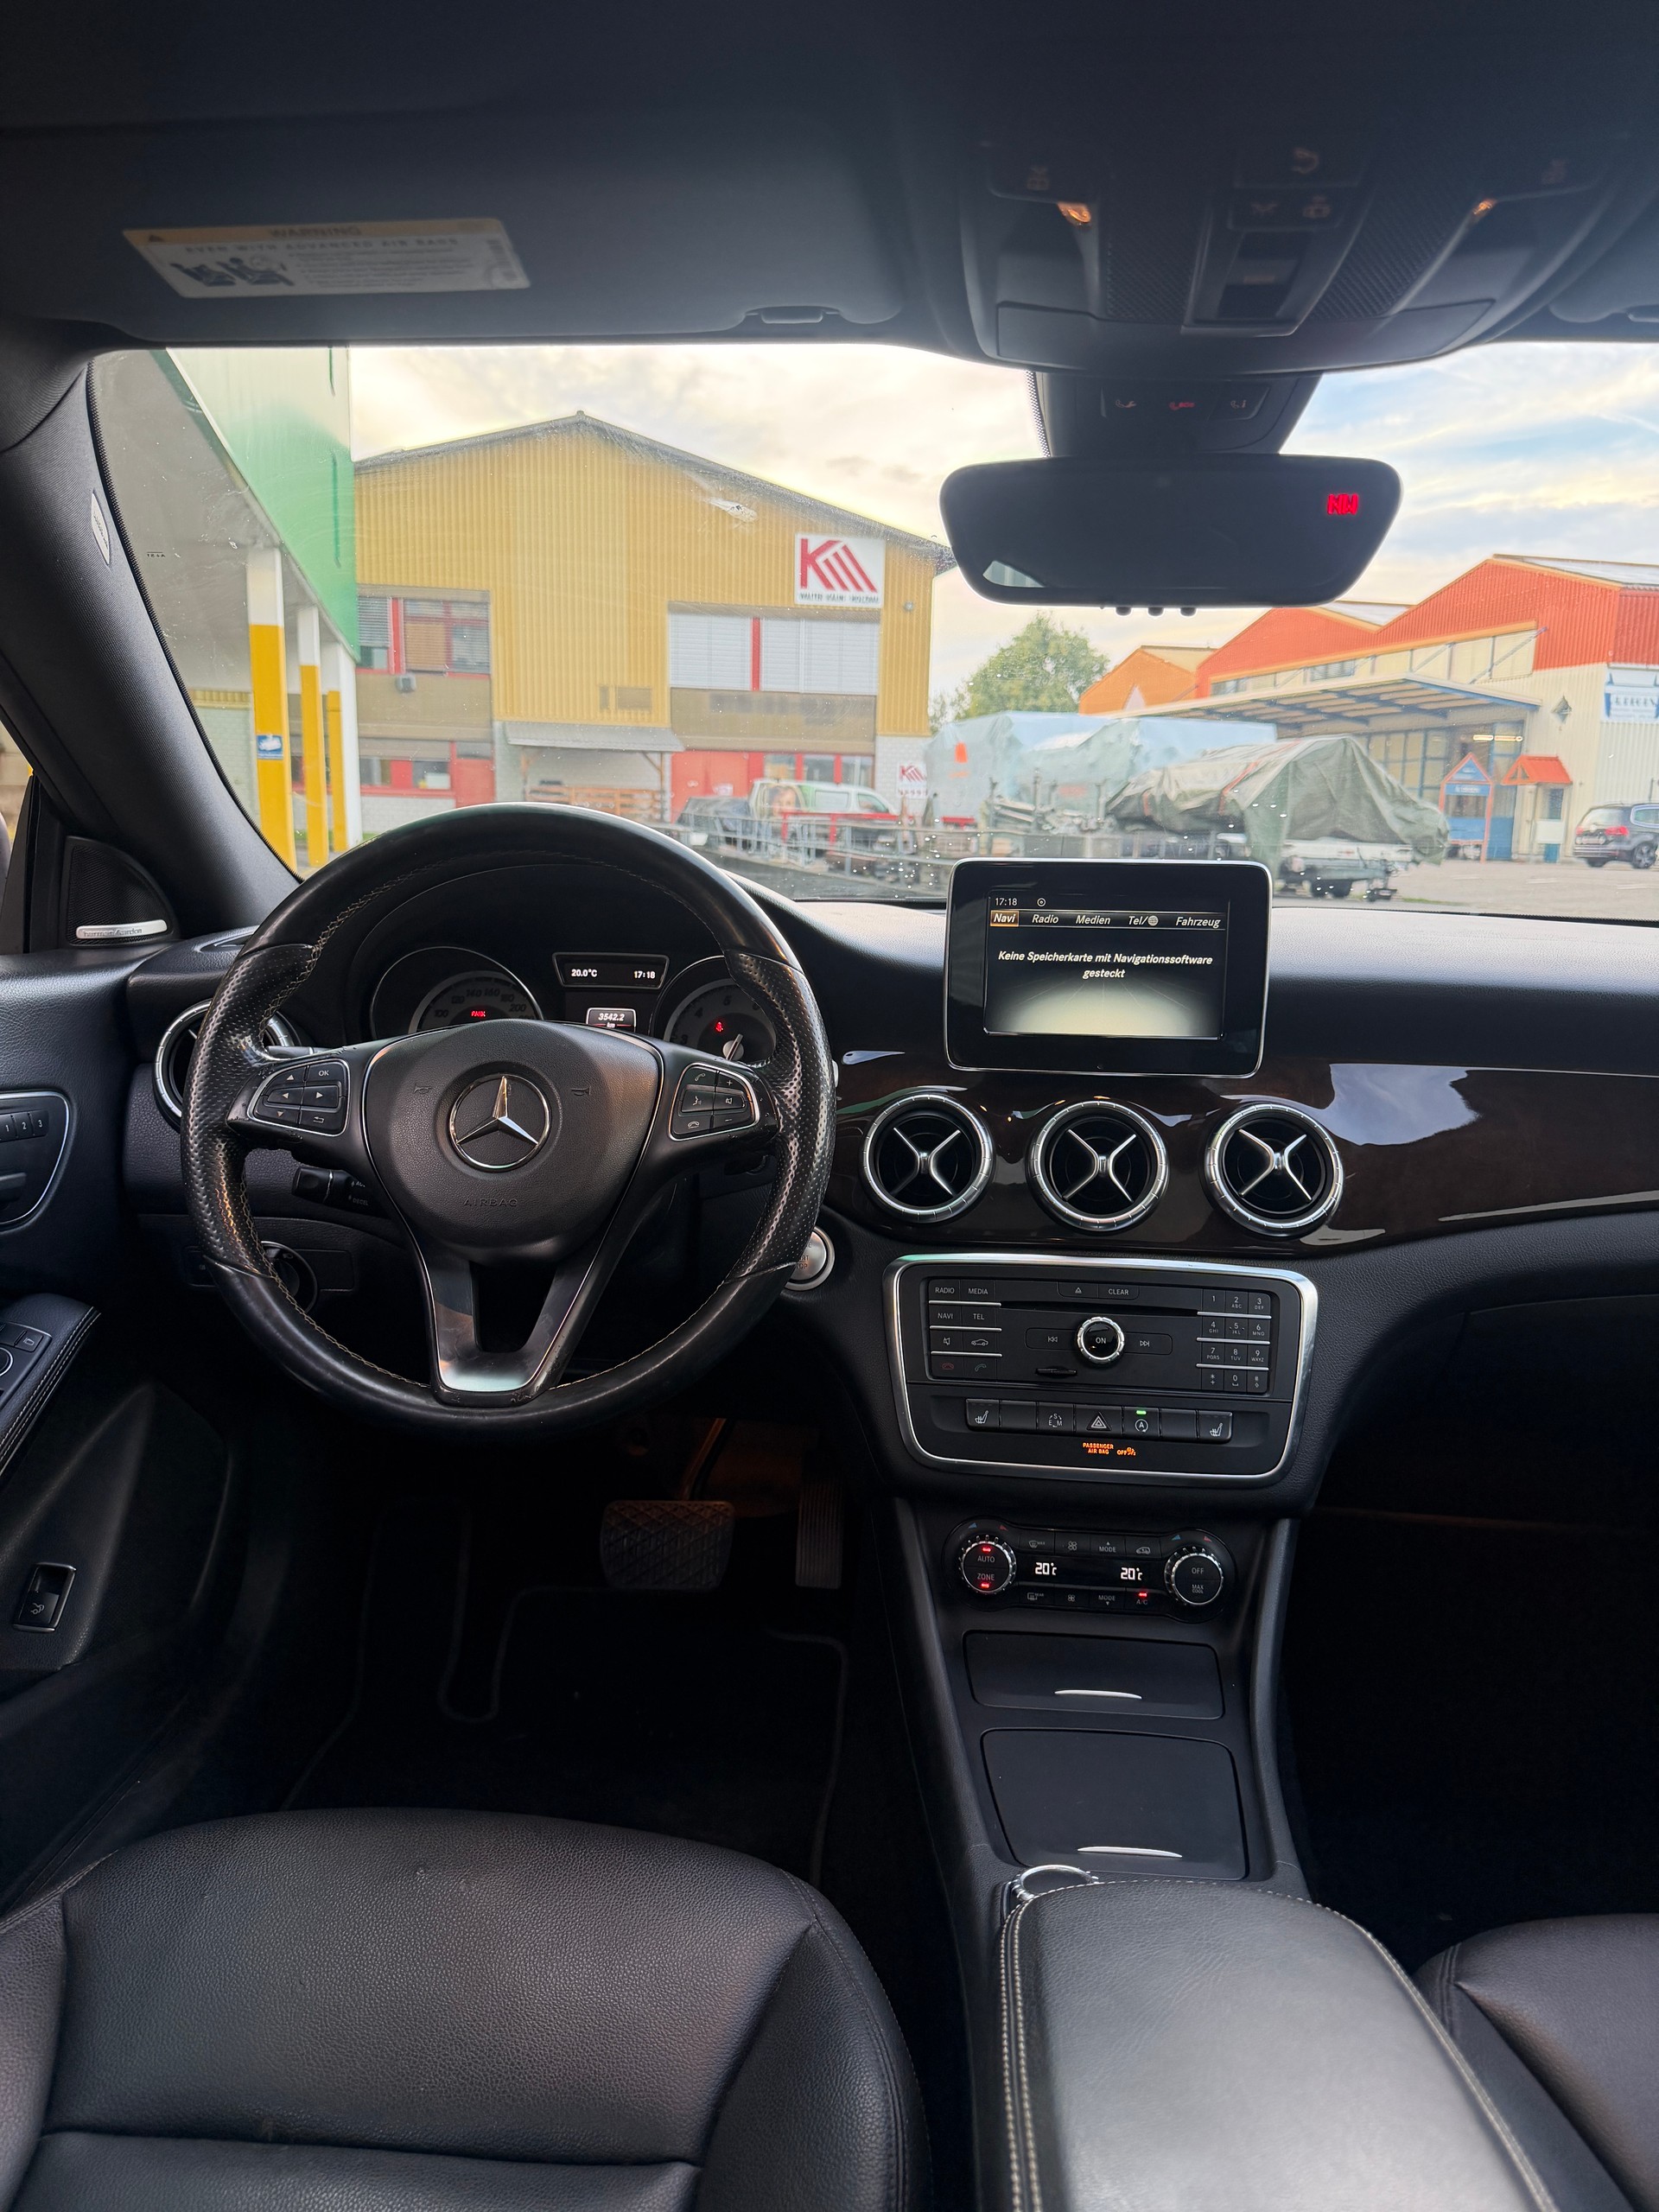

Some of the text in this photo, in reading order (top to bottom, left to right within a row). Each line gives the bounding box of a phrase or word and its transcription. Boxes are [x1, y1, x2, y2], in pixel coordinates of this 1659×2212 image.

[270, 226, 363, 238] WARNING
[234, 243, 277, 252] WITH
[995, 898, 1018, 906] 17:18
[993, 913, 1016, 924] Navi
[1032, 914, 1059, 925] Radio
[1076, 915, 1111, 925] Medien
[1175, 916, 1221, 929] Fahrzeug
[998, 950, 1213, 965] Keine Speicherkarte mit Navigationssoftware
[571, 968, 656, 980] 20.0°C 17:18
[1082, 968, 1125, 980] gesteckt
[598, 1012, 626, 1022] 3542.2
[22, 1121, 27, 1130] 2
[38, 1119, 43, 1128] 3
[463, 1198, 518, 1207] AIRBAG
[1095, 1336, 1107, 1344] ON
[1083, 1442, 1115, 1451] PASSENGER
